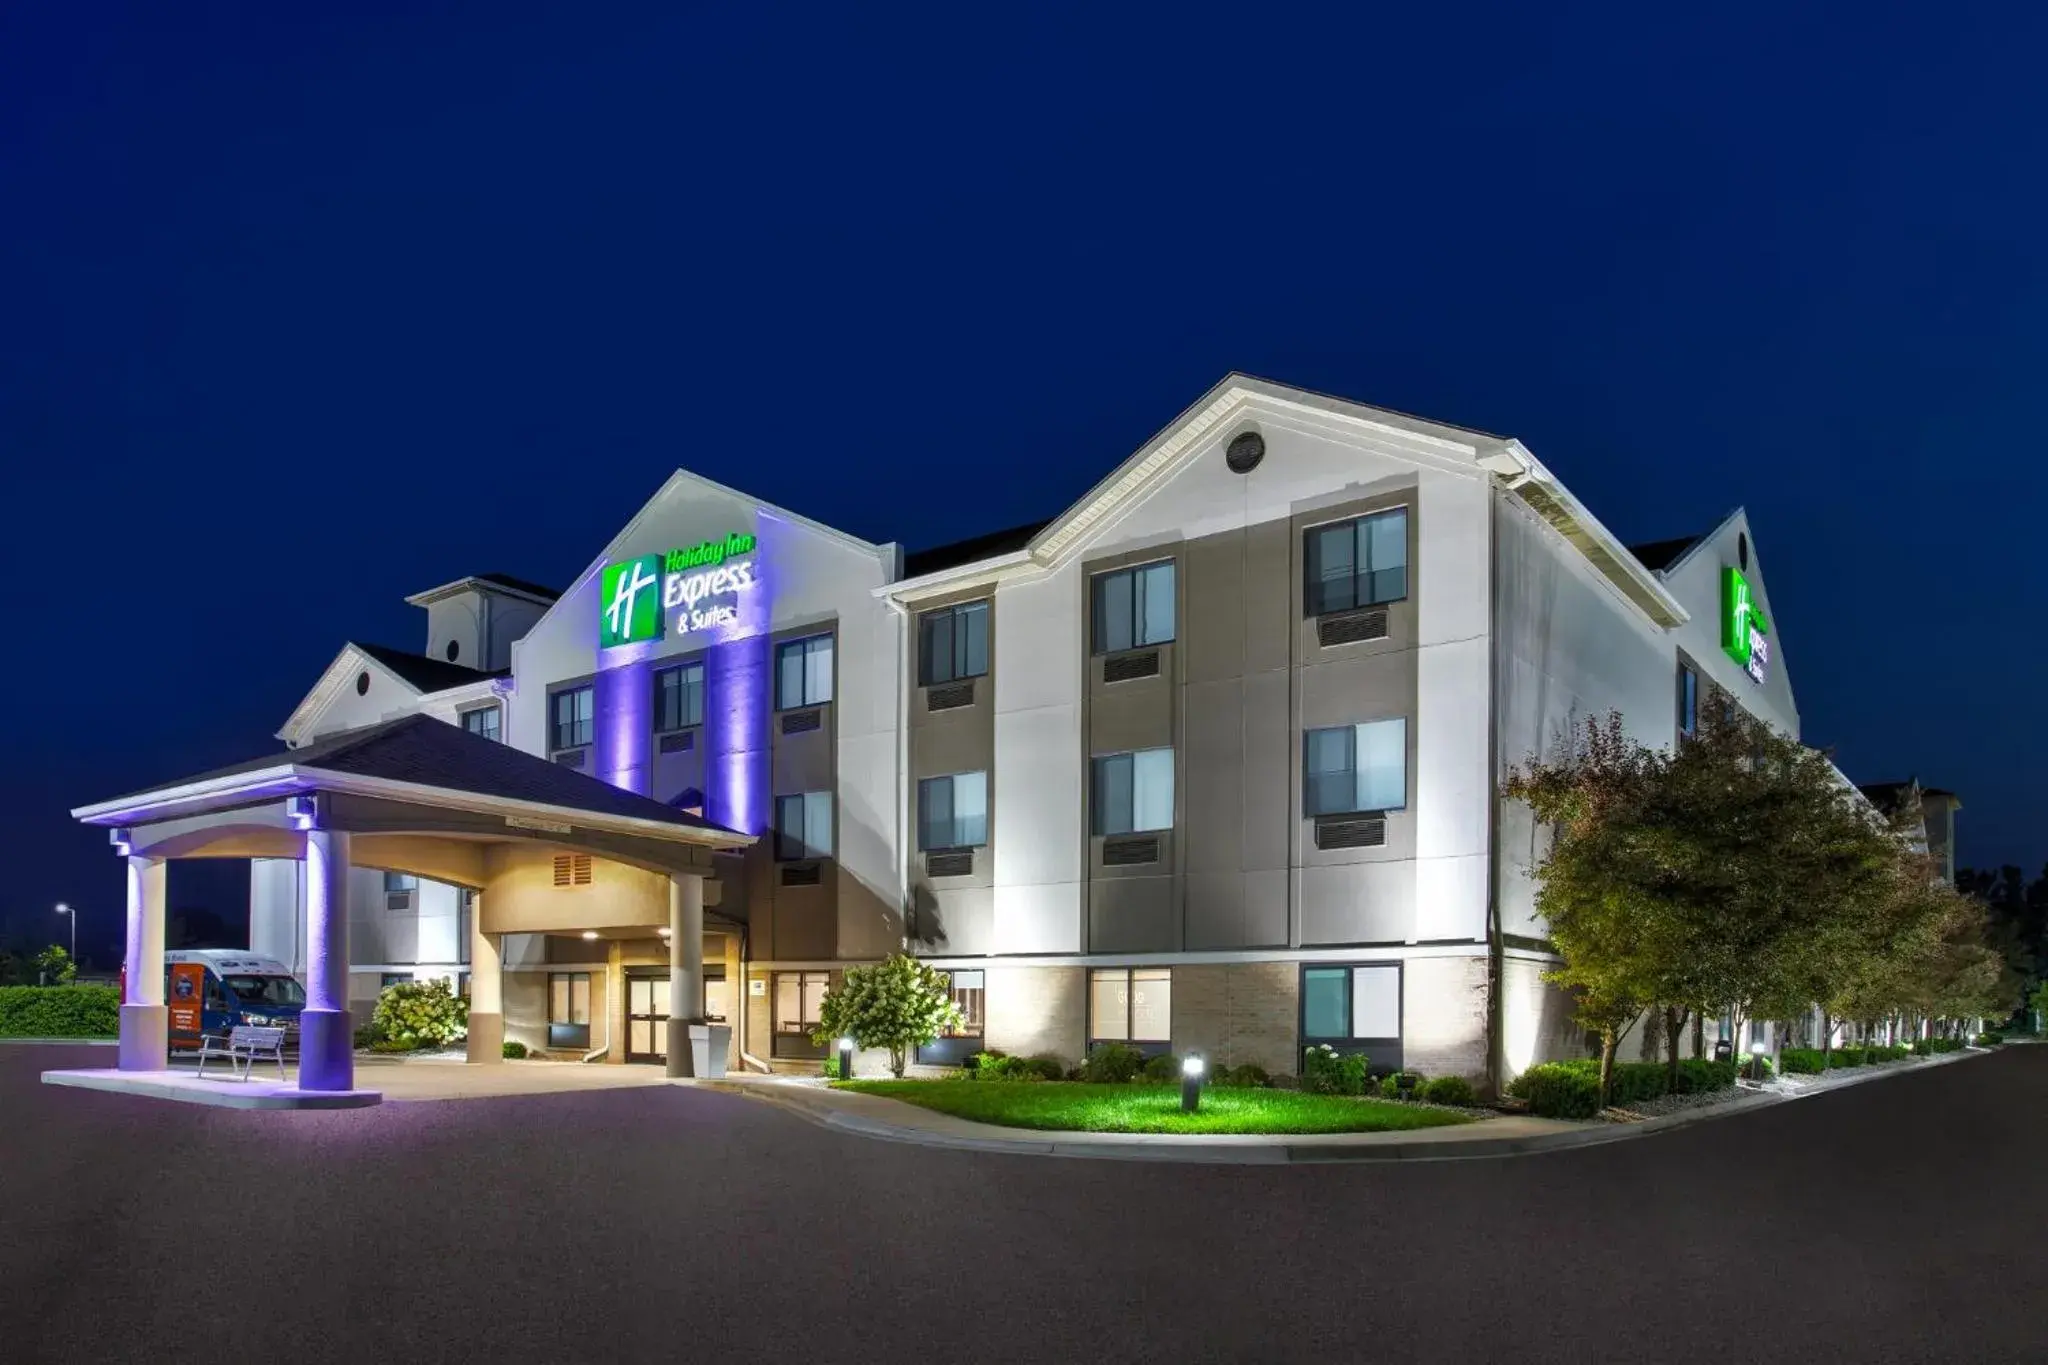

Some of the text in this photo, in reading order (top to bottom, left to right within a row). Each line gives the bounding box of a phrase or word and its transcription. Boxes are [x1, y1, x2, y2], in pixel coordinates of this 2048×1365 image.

[666, 533, 753, 573] Holiday Inn
[664, 561, 753, 610] Express
[678, 605, 738, 634] & Suites
